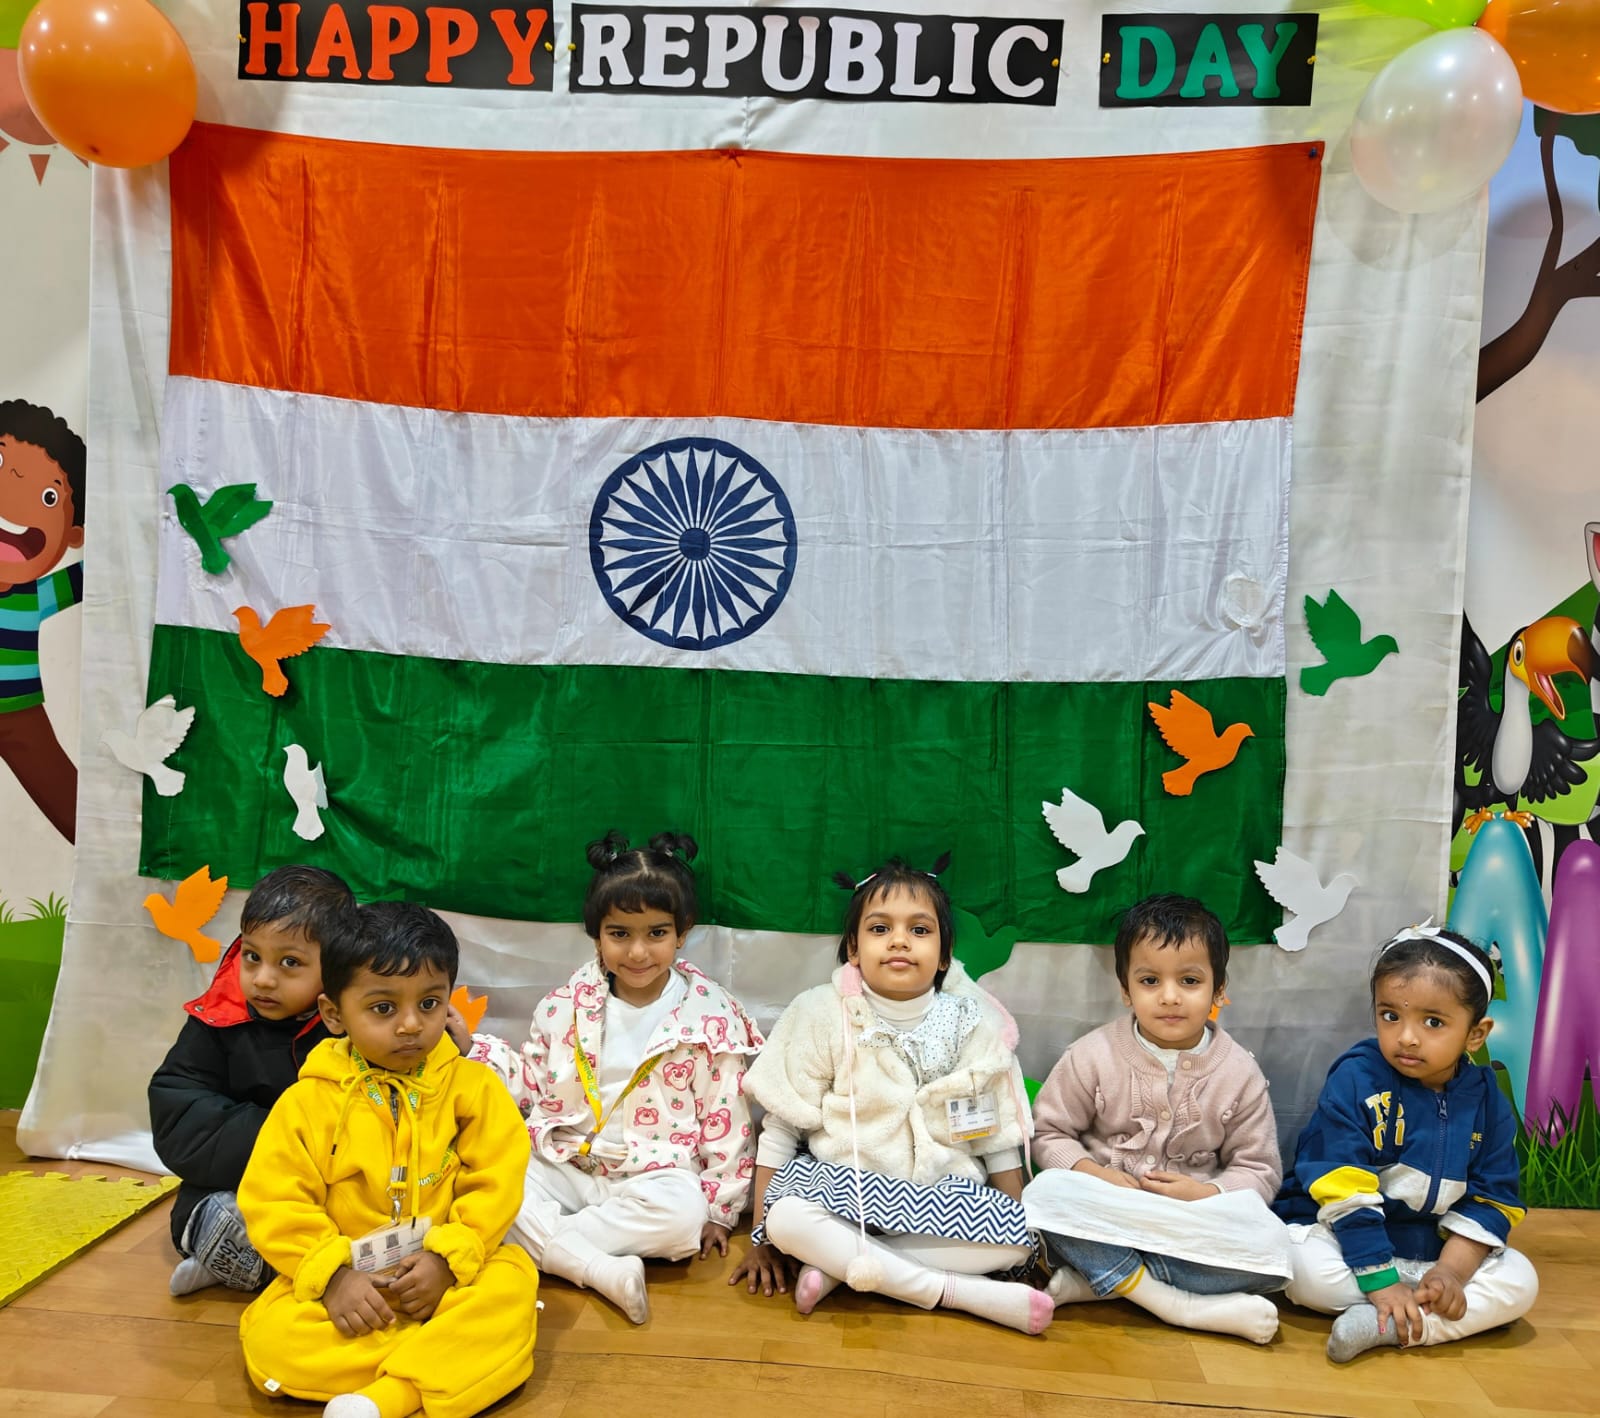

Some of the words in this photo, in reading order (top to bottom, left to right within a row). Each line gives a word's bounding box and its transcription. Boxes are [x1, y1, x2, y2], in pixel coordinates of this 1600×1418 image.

[246, 2, 547, 86] HAPPY
[577, 13, 1049, 98] REPUBLIC
[1115, 22, 1298, 99] DAY
